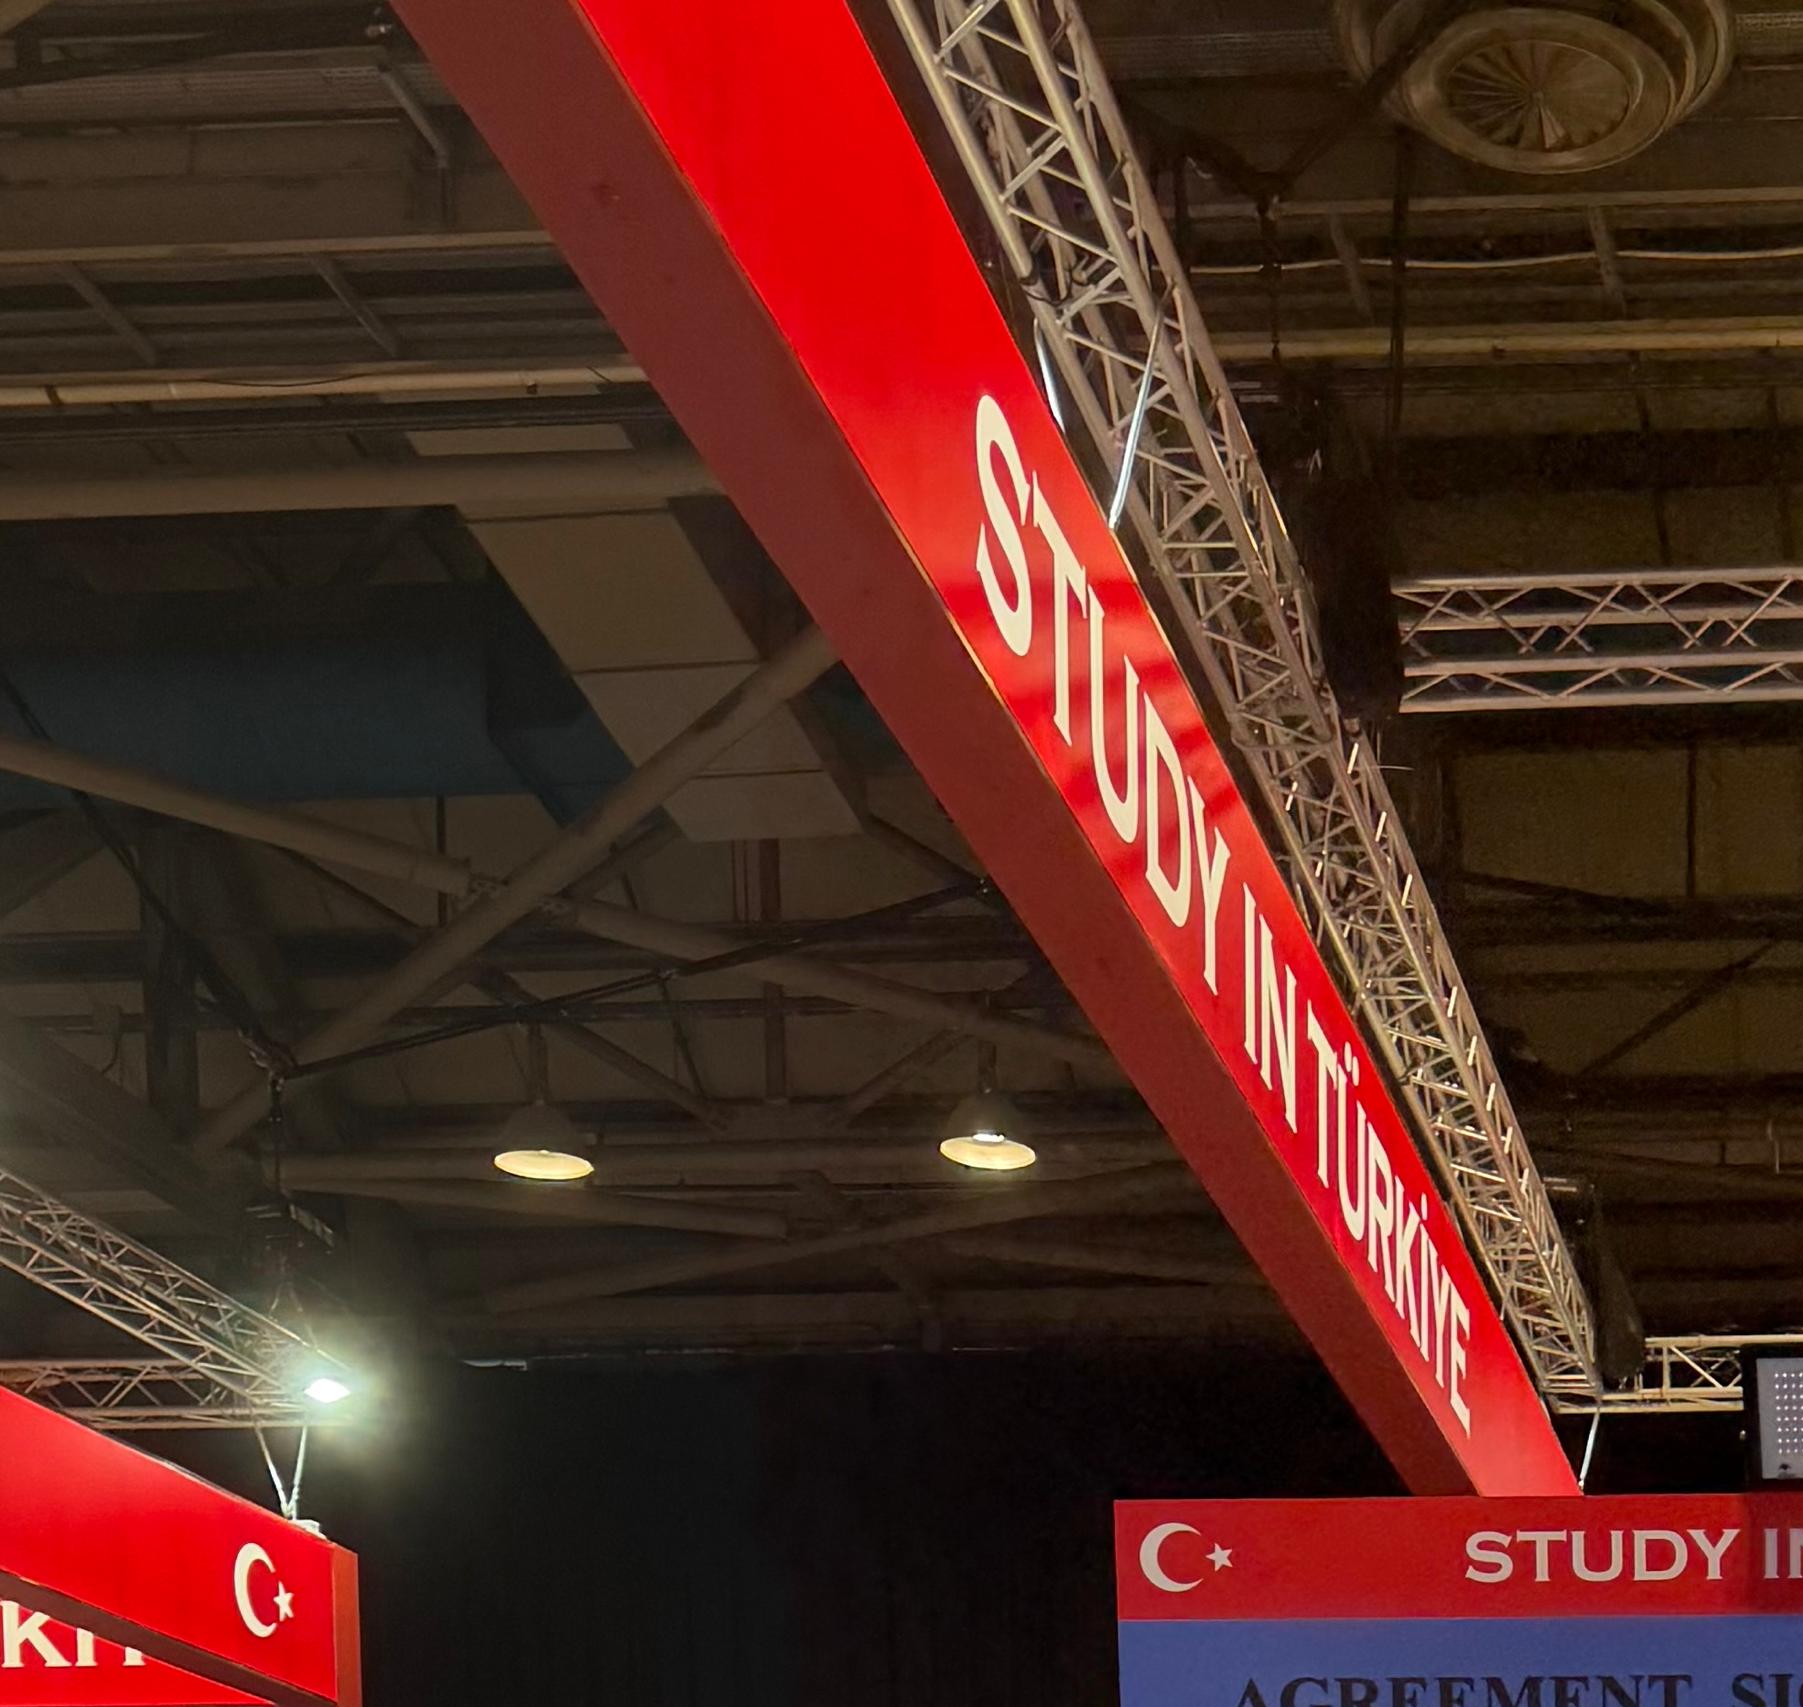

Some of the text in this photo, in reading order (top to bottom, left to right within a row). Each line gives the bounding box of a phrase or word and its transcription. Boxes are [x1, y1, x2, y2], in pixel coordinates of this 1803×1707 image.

[975, 393, 1473, 1438] STUDY IN TÜRKİYE
[1465, 1527, 1740, 1584] STUDY
